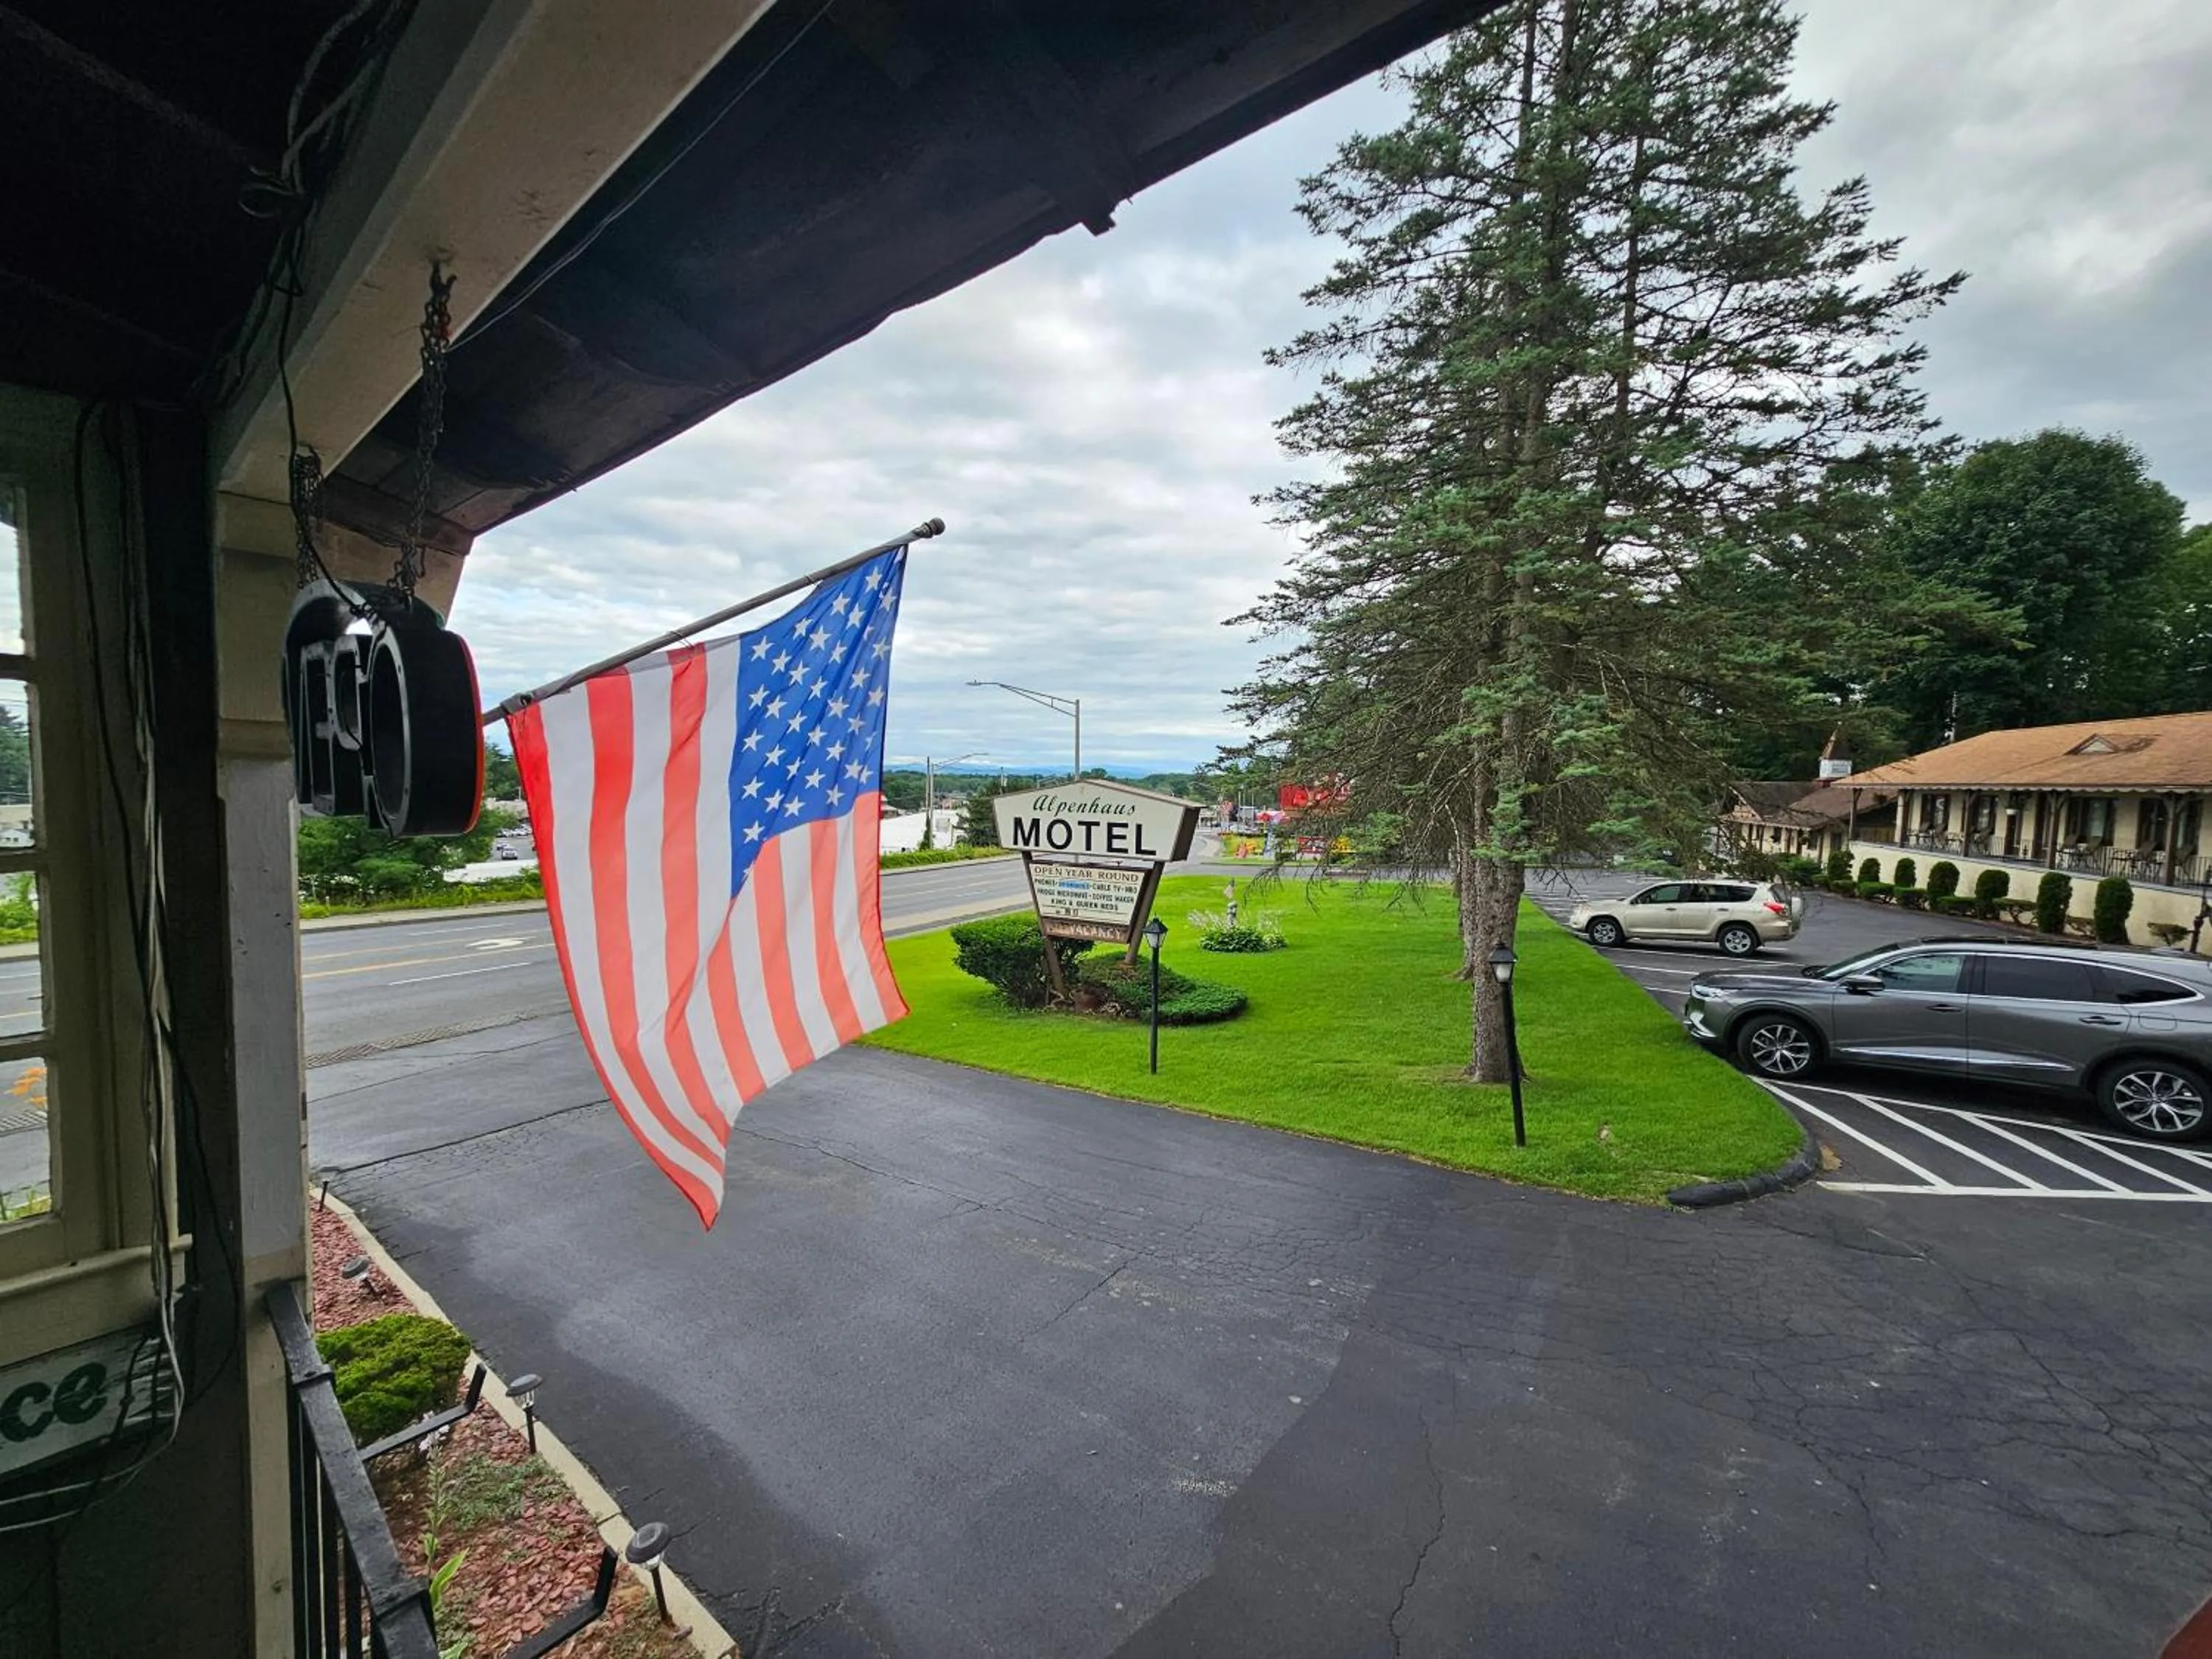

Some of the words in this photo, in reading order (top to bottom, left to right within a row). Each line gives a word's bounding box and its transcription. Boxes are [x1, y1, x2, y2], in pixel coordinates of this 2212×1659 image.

[1033, 794, 1136, 816] Alpenhaus
[1012, 816, 1157, 856] MOTEL
[1034, 866, 1062, 876] OPEN
[1065, 869, 1092, 879] YEAR
[1097, 871, 1139, 883] ROUND
[1077, 900, 1098, 909] QUEEN
[1071, 923, 1121, 939] VACANCY
